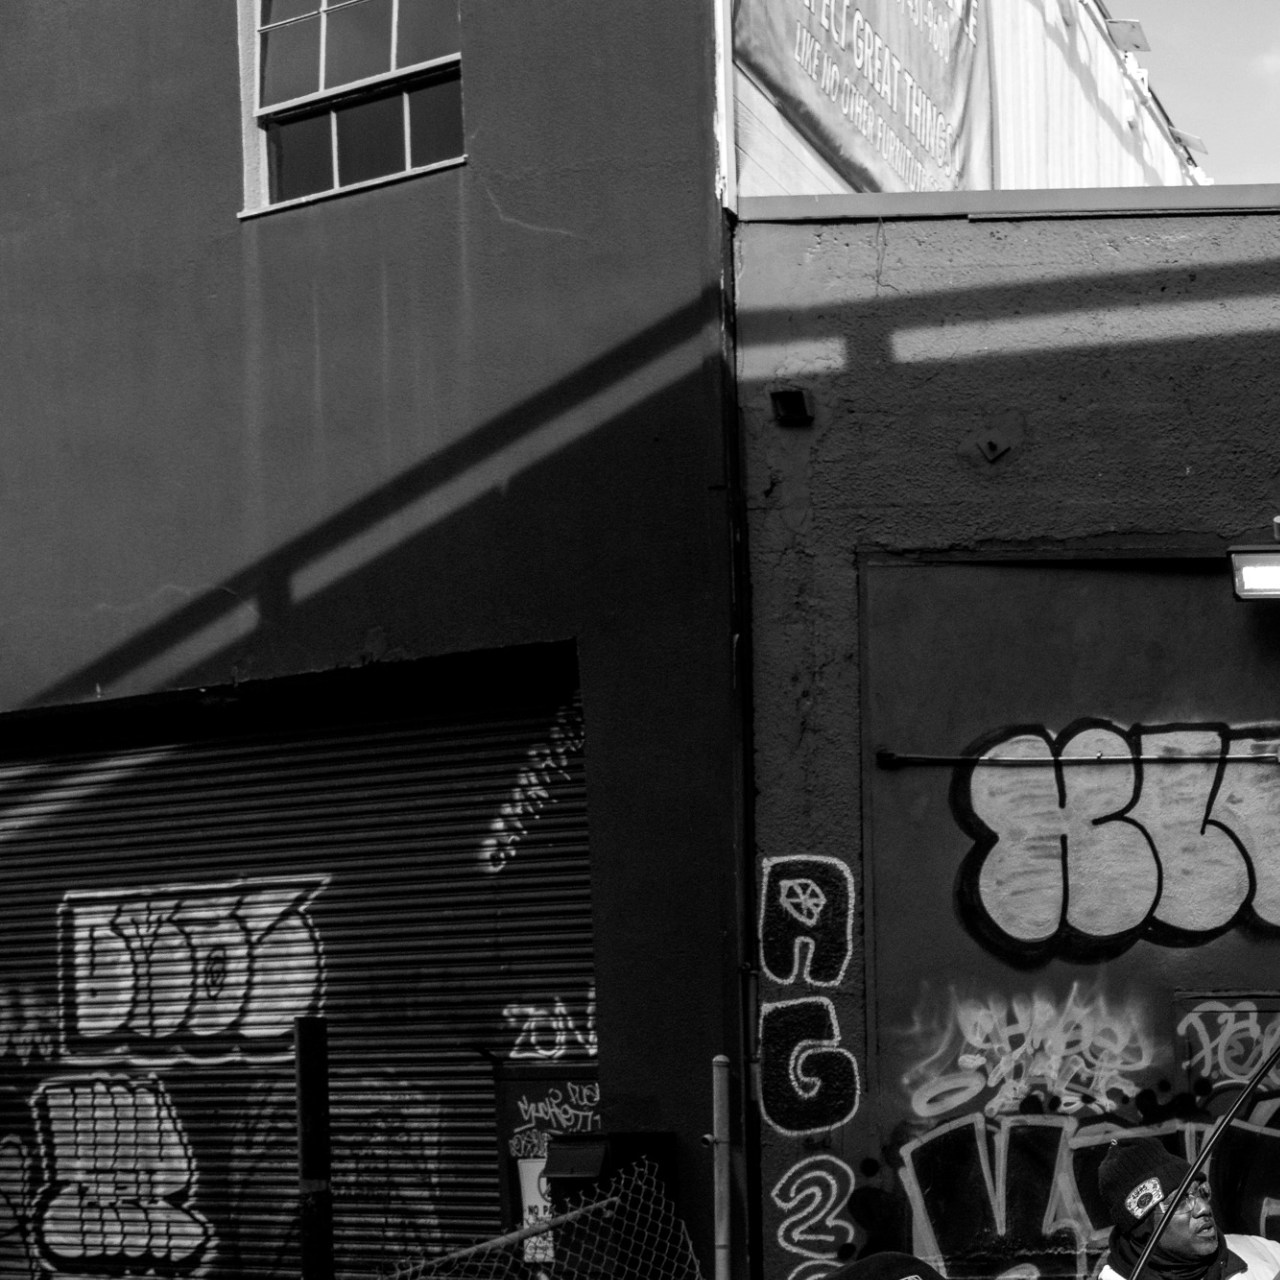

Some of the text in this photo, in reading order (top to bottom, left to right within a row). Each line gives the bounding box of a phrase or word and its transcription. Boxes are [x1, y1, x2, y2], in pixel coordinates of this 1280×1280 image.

[794, 20, 821, 81] LIKE
[821, 51, 841, 103] NO
[840, 76, 875, 145] OTHER
[852, 9, 901, 114] GREAT
